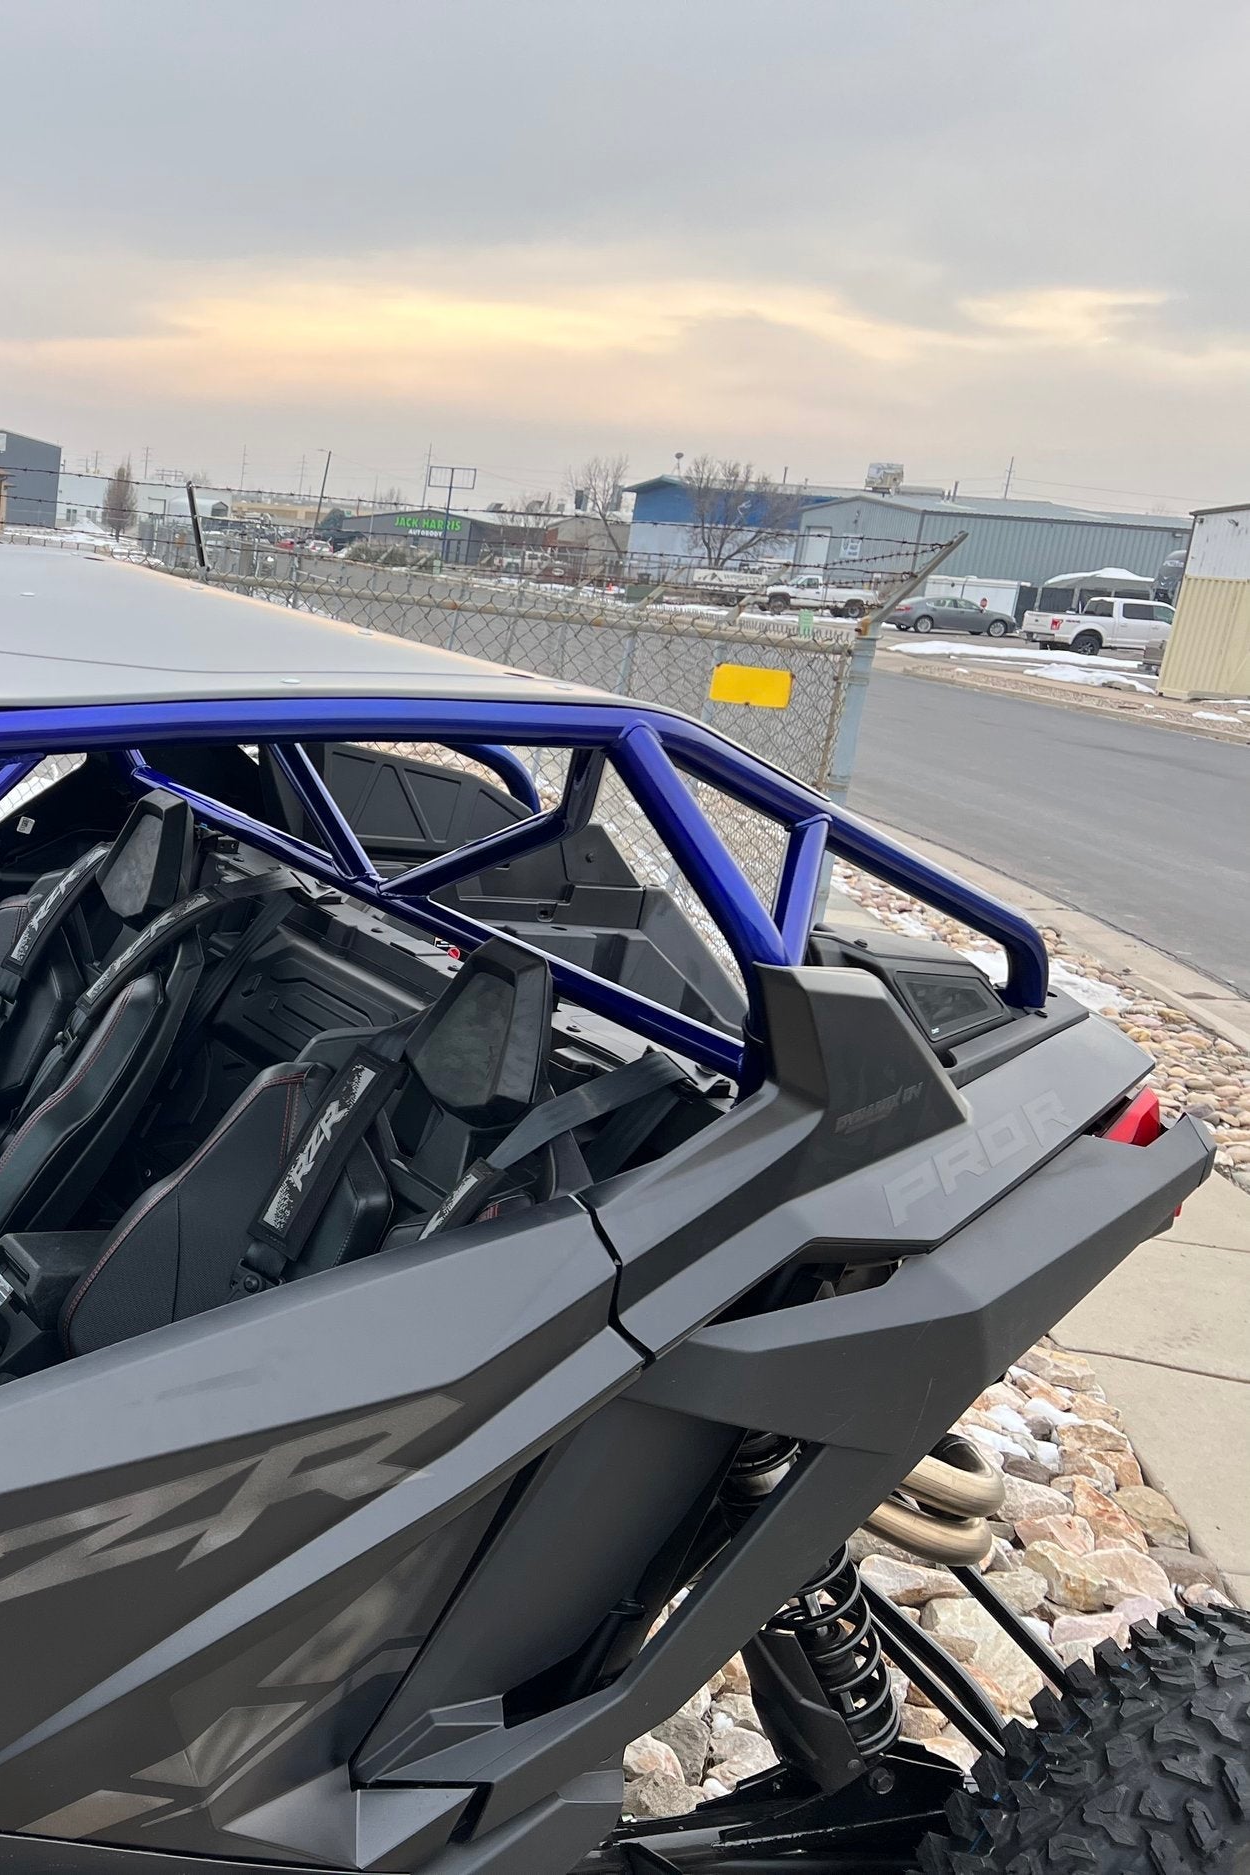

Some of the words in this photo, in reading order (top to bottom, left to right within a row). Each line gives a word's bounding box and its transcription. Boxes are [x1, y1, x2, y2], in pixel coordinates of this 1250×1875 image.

[394, 516, 419, 528] JACK
[408, 528, 443, 537] AUTOBODY
[289, 1099, 350, 1193] RZR
